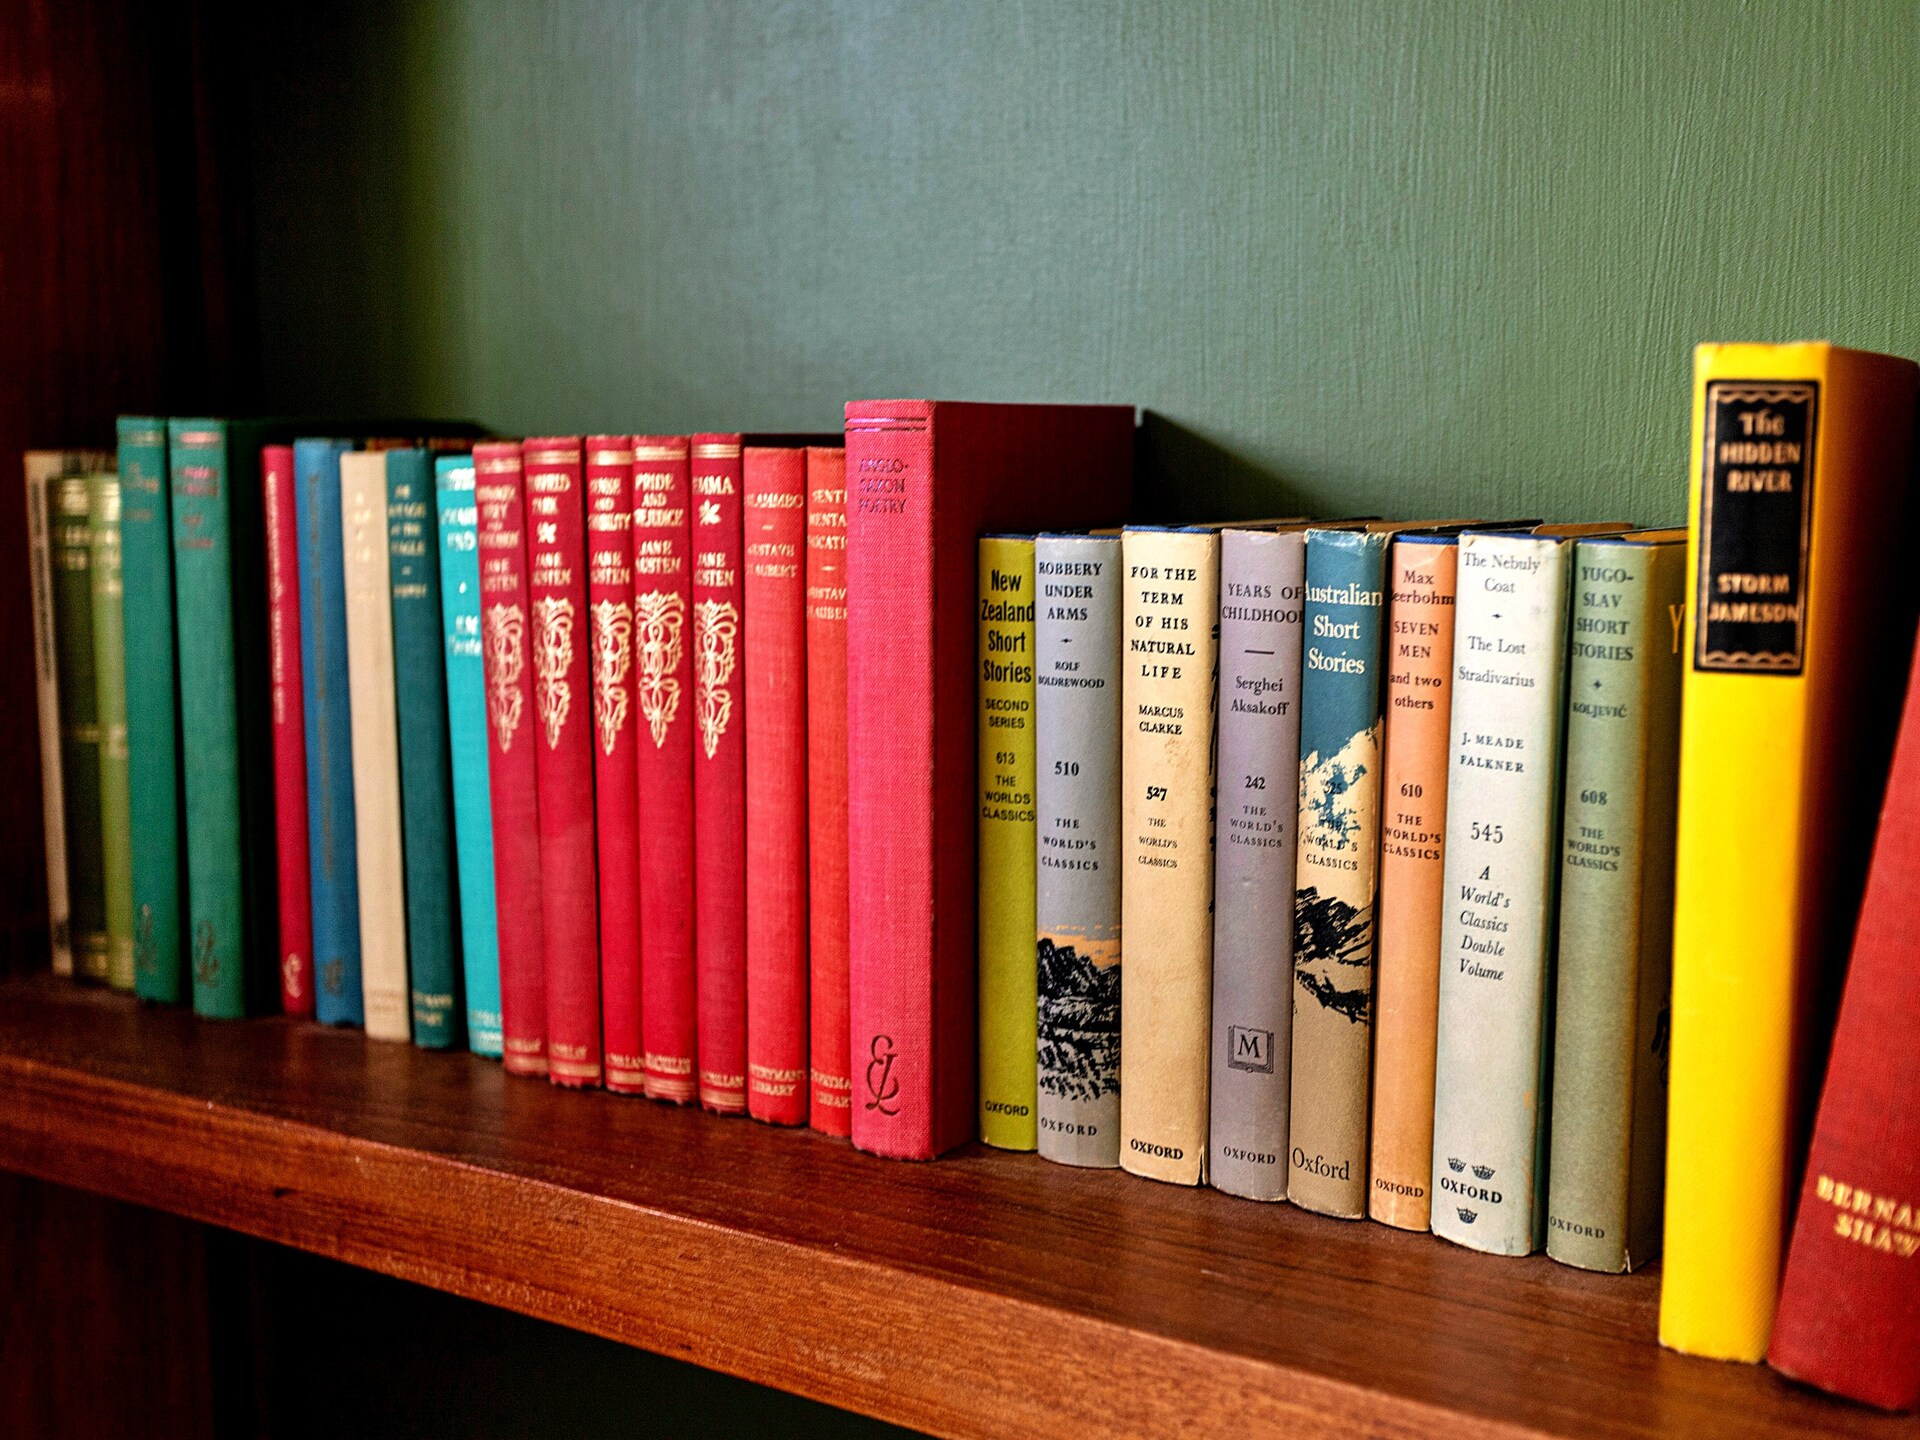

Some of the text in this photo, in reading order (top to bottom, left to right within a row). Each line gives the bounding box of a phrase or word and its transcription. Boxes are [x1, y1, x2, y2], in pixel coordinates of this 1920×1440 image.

[1720, 441, 1800, 465] HIDDEN
[1727, 470, 1792, 493] RIVER
[1038, 561, 1103, 577] ROBBERY
[1464, 552, 1540, 575] The Nebuly
[991, 570, 1021, 591] New
[1131, 566, 1197, 581] FOR THE
[1403, 570, 1434, 585] Max
[1582, 566, 1634, 583] YUGO-
[1045, 584, 1093, 598] UNDER
[1228, 583, 1303, 600] YEARS OF
[1484, 577, 1516, 593] Coat
[1717, 573, 1790, 594] STORM
[1141, 591, 1184, 606] TERM
[1391, 589, 1456, 605] eerbohm
[1583, 592, 1623, 608] SLAV
[982, 599, 1035, 622] Zealand
[1047, 606, 1088, 621] ARMS
[1135, 615, 1189, 630] OF HIS
[1313, 614, 1361, 640] Short
[1394, 621, 1439, 636] SEVEN
[1576, 617, 1630, 635] SHORT
[988, 630, 1026, 653] Short
[1130, 639, 1196, 656] NATURAL
[1468, 635, 1526, 655] The Lost
[1399, 644, 1431, 658] MEN
[1572, 643, 1634, 661] STORIES
[1055, 661, 1080, 671] ROLF
[1308, 647, 1366, 675] Stories
[983, 661, 1032, 684] Stories
[1141, 665, 1182, 680] LIFE
[1390, 672, 1442, 688] and two
[1458, 666, 1535, 688] Stradivarius
[1235, 675, 1284, 696] Serghei
[985, 698, 1029, 712] SECOND
[1230, 699, 1290, 716] Aksakoff
[1394, 695, 1434, 710] others
[1139, 705, 1184, 719] MARCUS
[989, 716, 1025, 729] SERIES
[1139, 721, 1183, 736] CLARKE
[1462, 732, 1525, 749] J. MEADE
[996, 752, 1015, 764] 613
[1460, 755, 1525, 773] FALKNER
[1054, 761, 1080, 776] 510
[995, 775, 1016, 787] THE
[1245, 775, 1266, 790] 242
[1146, 786, 1168, 802] 527
[1401, 783, 1423, 798] 610
[1580, 789, 1608, 806] 608
[982, 807, 1035, 822] CLASSICS
[1242, 805, 1267, 816] THE
[1055, 818, 1080, 829] THE
[1147, 817, 1167, 828] THE
[1230, 818, 1284, 833] WORLD'S
[1397, 813, 1422, 826] THE
[1230, 833, 1283, 849] CLASSICS
[1384, 827, 1441, 844] WORLD'S
[1470, 822, 1503, 844] 545
[1580, 826, 1604, 840] THE
[1042, 836, 1097, 850] WORLD'S
[1138, 836, 1178, 850] WORLD'S
[1383, 843, 1440, 860] CLASSICS
[1567, 840, 1621, 857] WORLD'S
[1041, 857, 1099, 872] CLASSICS
[1138, 855, 1178, 869] CLASSICS
[1306, 853, 1358, 871] CLASSICS
[1567, 855, 1618, 872] CLASSICS
[1479, 865, 1490, 881] A
[1461, 885, 1511, 908] World's
[1460, 910, 1509, 933] Classics
[1461, 935, 1506, 957] Double
[1460, 958, 1504, 981] Volume
[985, 1100, 1029, 1117] OXFORD
[1041, 1117, 1097, 1137] OXFORD
[1130, 1138, 1184, 1160] OXFORD
[1223, 1145, 1276, 1165] OXFORD
[1292, 1147, 1351, 1181] Oxford
[1375, 1178, 1424, 1198] OXFORD
[1440, 1176, 1503, 1204] OXFORD
[1549, 1216, 1605, 1239] OXFORD
